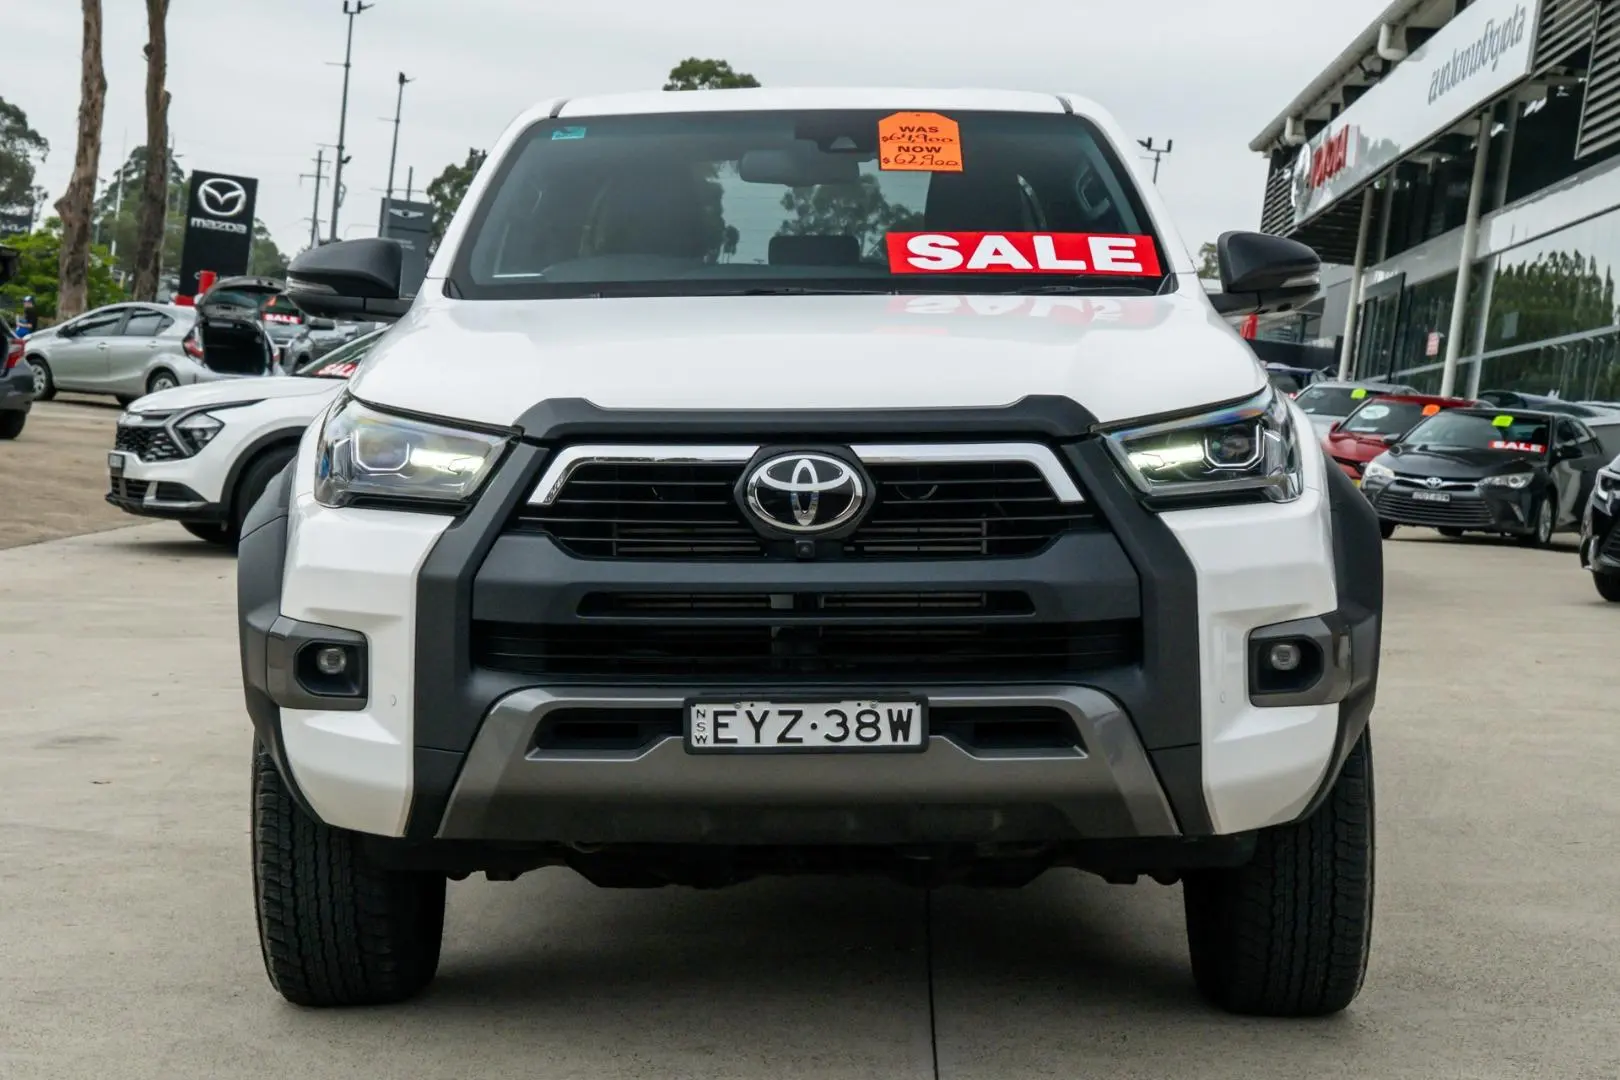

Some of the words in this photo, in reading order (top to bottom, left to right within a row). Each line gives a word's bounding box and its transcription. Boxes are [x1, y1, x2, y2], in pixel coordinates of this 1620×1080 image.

[906, 234, 1143, 272] SALE
[1493, 440, 1543, 453] SALE
[694, 708, 708, 744] NSW
